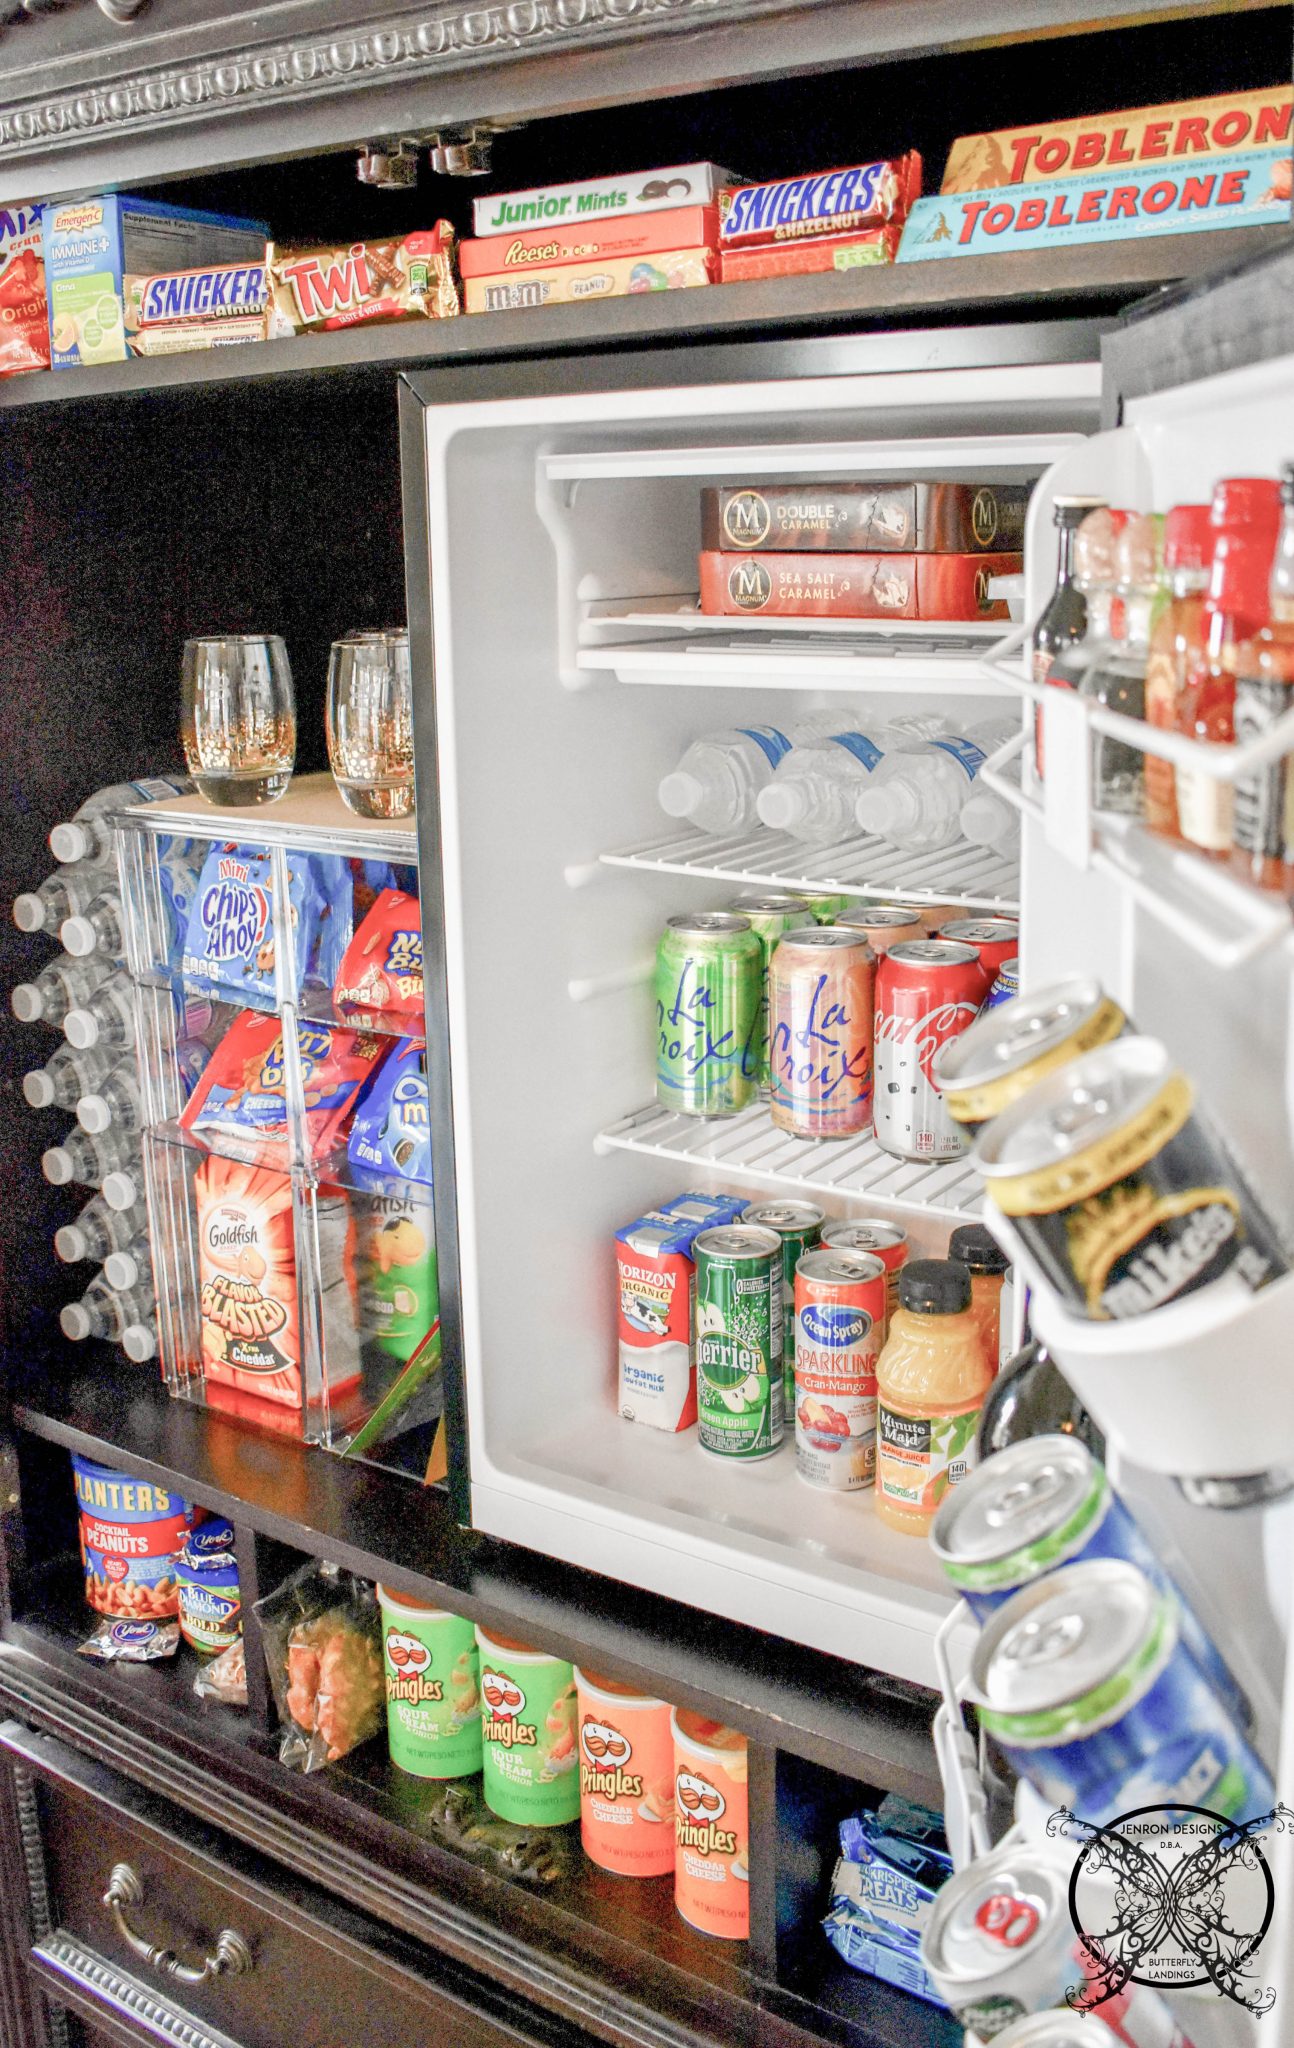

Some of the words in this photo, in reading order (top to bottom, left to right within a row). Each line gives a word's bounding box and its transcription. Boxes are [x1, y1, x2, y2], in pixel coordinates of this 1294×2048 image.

[491, 196, 571, 227] Junior
[576, 189, 628, 213] Mints
[725, 163, 886, 235] SNICKERS
[958, 170, 1249, 245] TOBLERONE
[148, 267, 268, 319] SNICKER
[777, 504, 835, 519] DOUBLE
[781, 519, 831, 530] CARAMEL
[779, 572, 800, 584] SEA
[807, 572, 836, 585] SALT
[779, 587, 836, 600] CARAMEL
[219, 857, 250, 884] Mini
[203, 883, 258, 928] Chips
[667, 956, 717, 1027] La
[795, 973, 852, 1049] La
[209, 1224, 258, 1248] Goldfish
[202, 1283, 287, 1338] BLASTED
[804, 1313, 832, 1340] Ocean
[833, 1319, 864, 1342] Spray
[232, 1347, 275, 1366] Cheddar
[796, 1344, 877, 1375] SPARKLING
[723, 1416, 749, 1429] Apple
[881, 1411, 926, 1435] Minute
[884, 1426, 918, 1447] Maid
[951, 1464, 964, 1473] 140
[86, 1526, 149, 1554] PEANUTS
[94, 1522, 131, 1537] COCKTAIL
[200, 1531, 229, 1547] York
[188, 1586, 216, 1605] BLUE
[186, 1614, 221, 1633] BOLD
[386, 1674, 443, 1706] Pringles
[397, 1704, 429, 1720] SOUR
[482, 1714, 536, 1748] Pringles
[581, 1763, 642, 1800] Pringles
[677, 1815, 737, 1856] Pringles
[870, 1867, 918, 1896] KRISPIES
